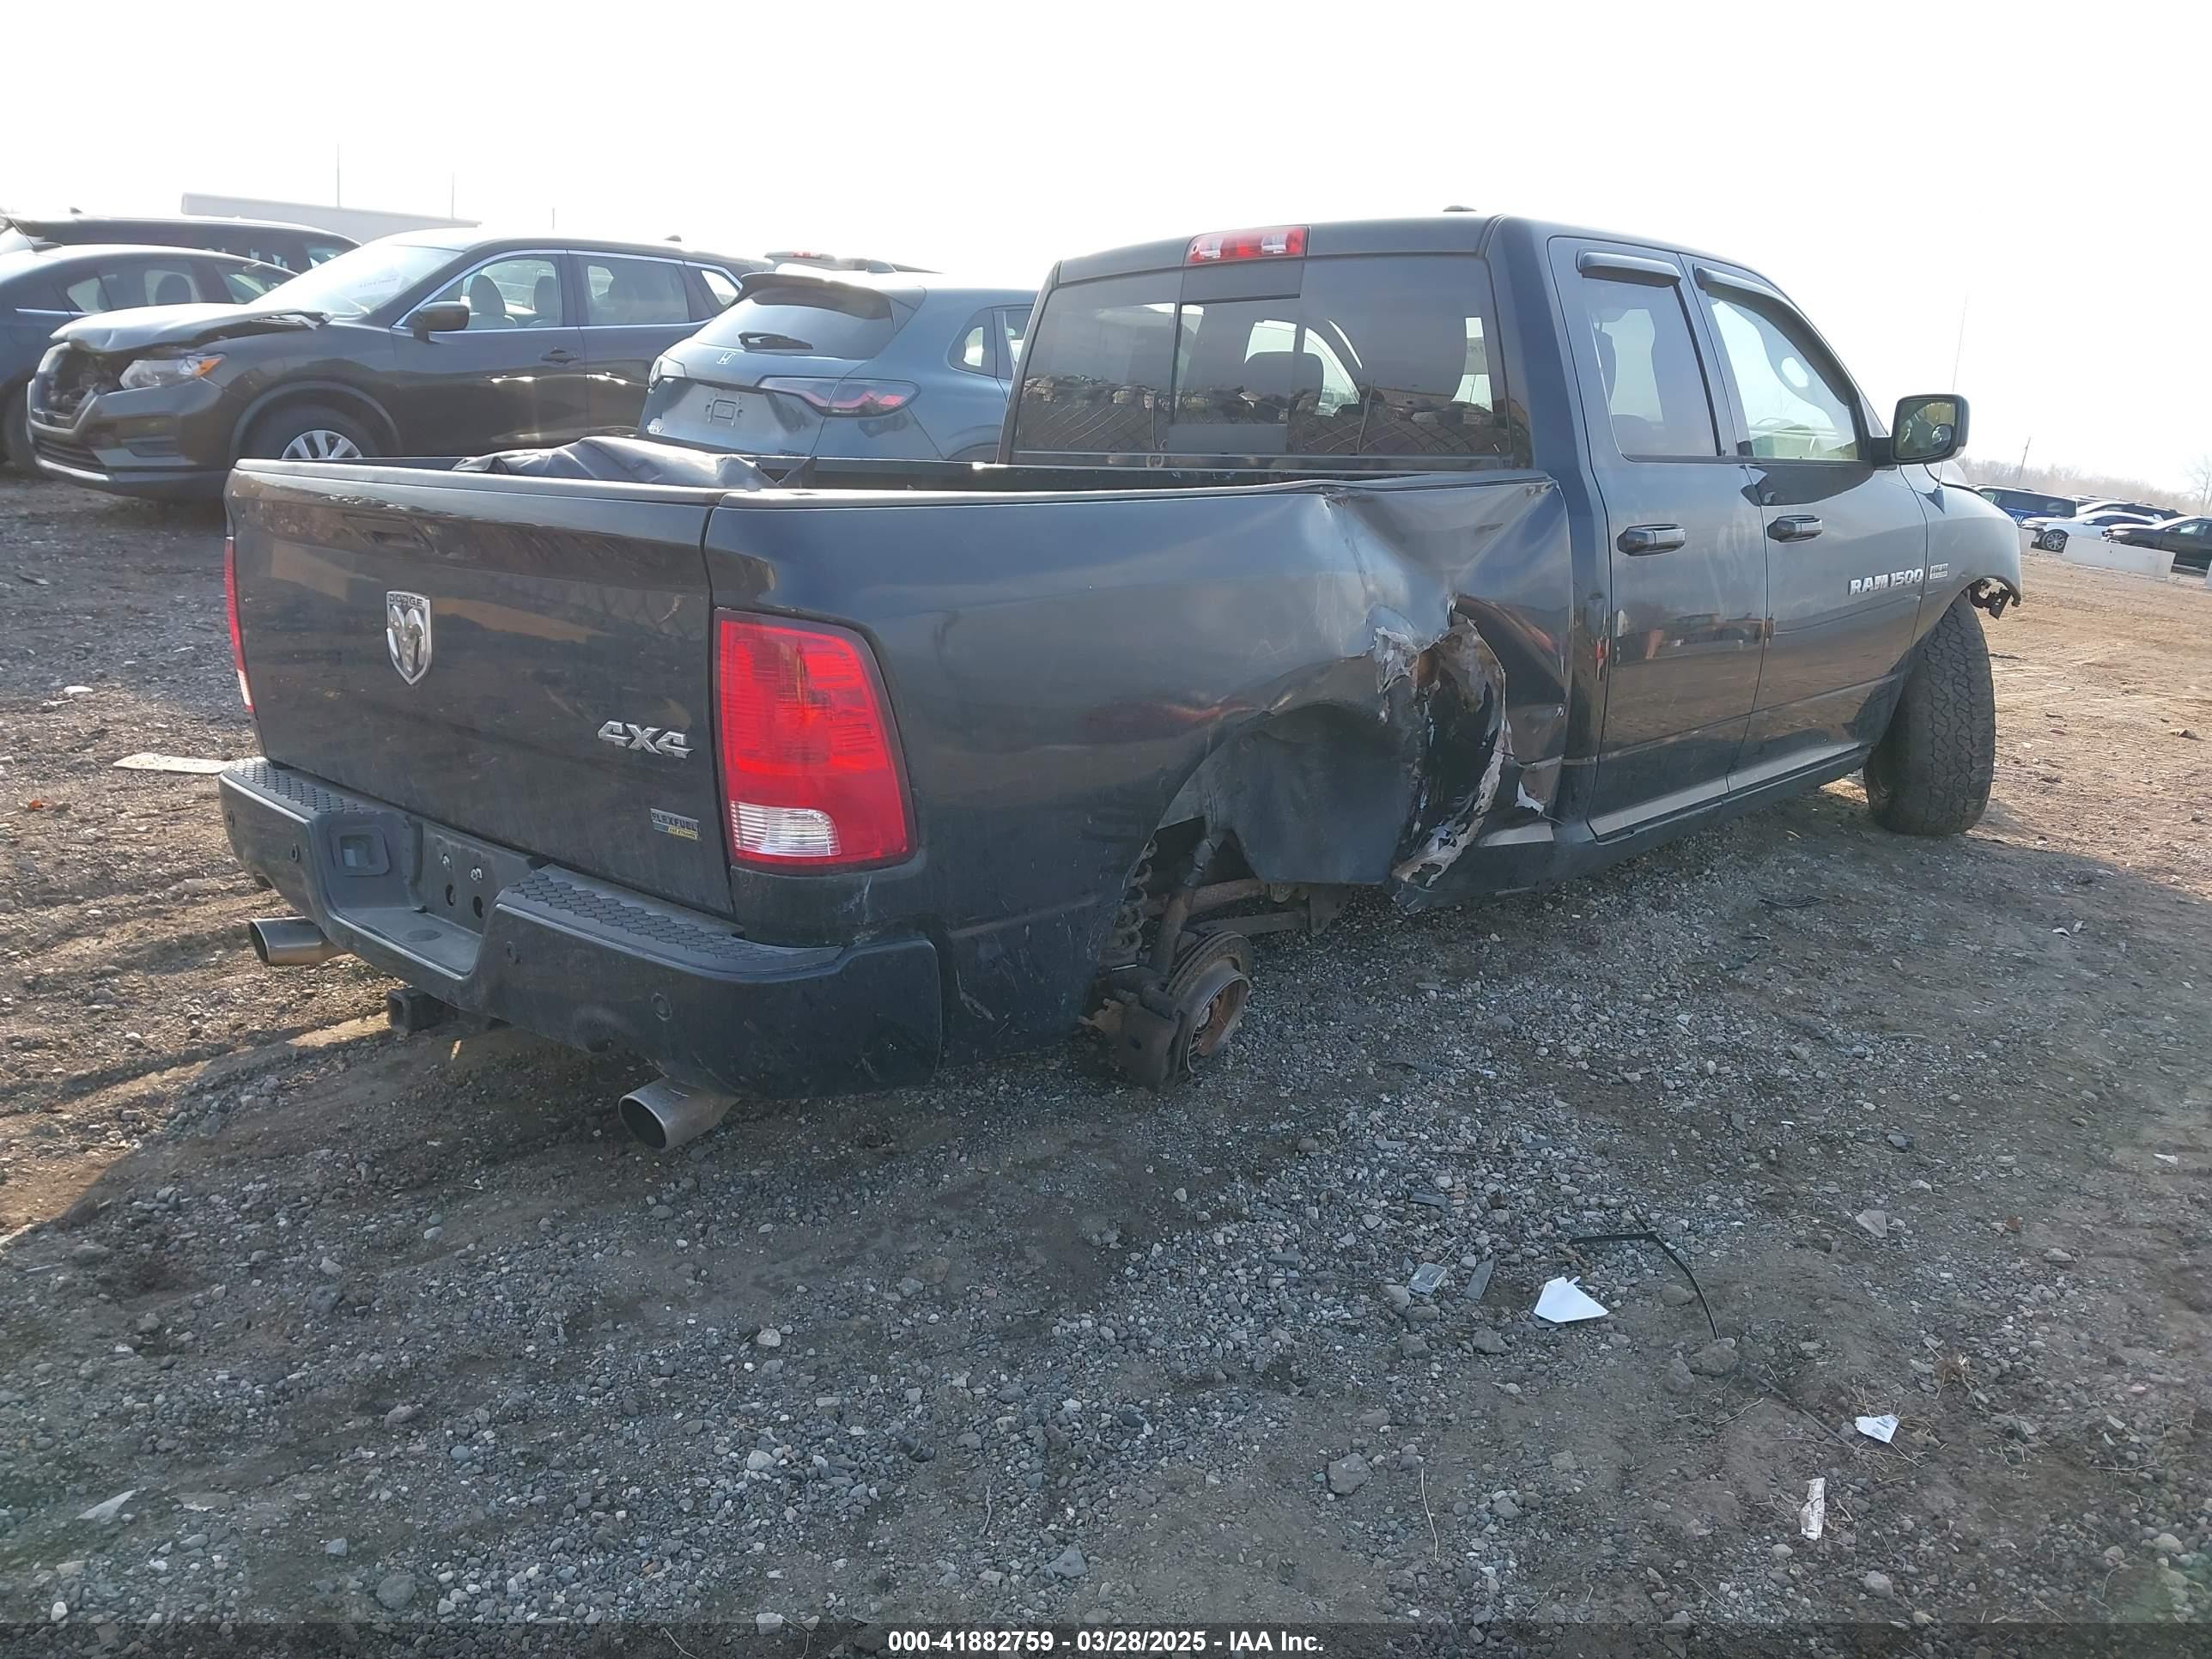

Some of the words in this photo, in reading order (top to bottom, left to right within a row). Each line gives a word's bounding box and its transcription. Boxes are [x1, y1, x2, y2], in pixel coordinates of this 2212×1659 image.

[1850, 574, 1889, 596] RAM
[1890, 568, 1924, 588] 1500
[389, 594, 423, 606] DODGE
